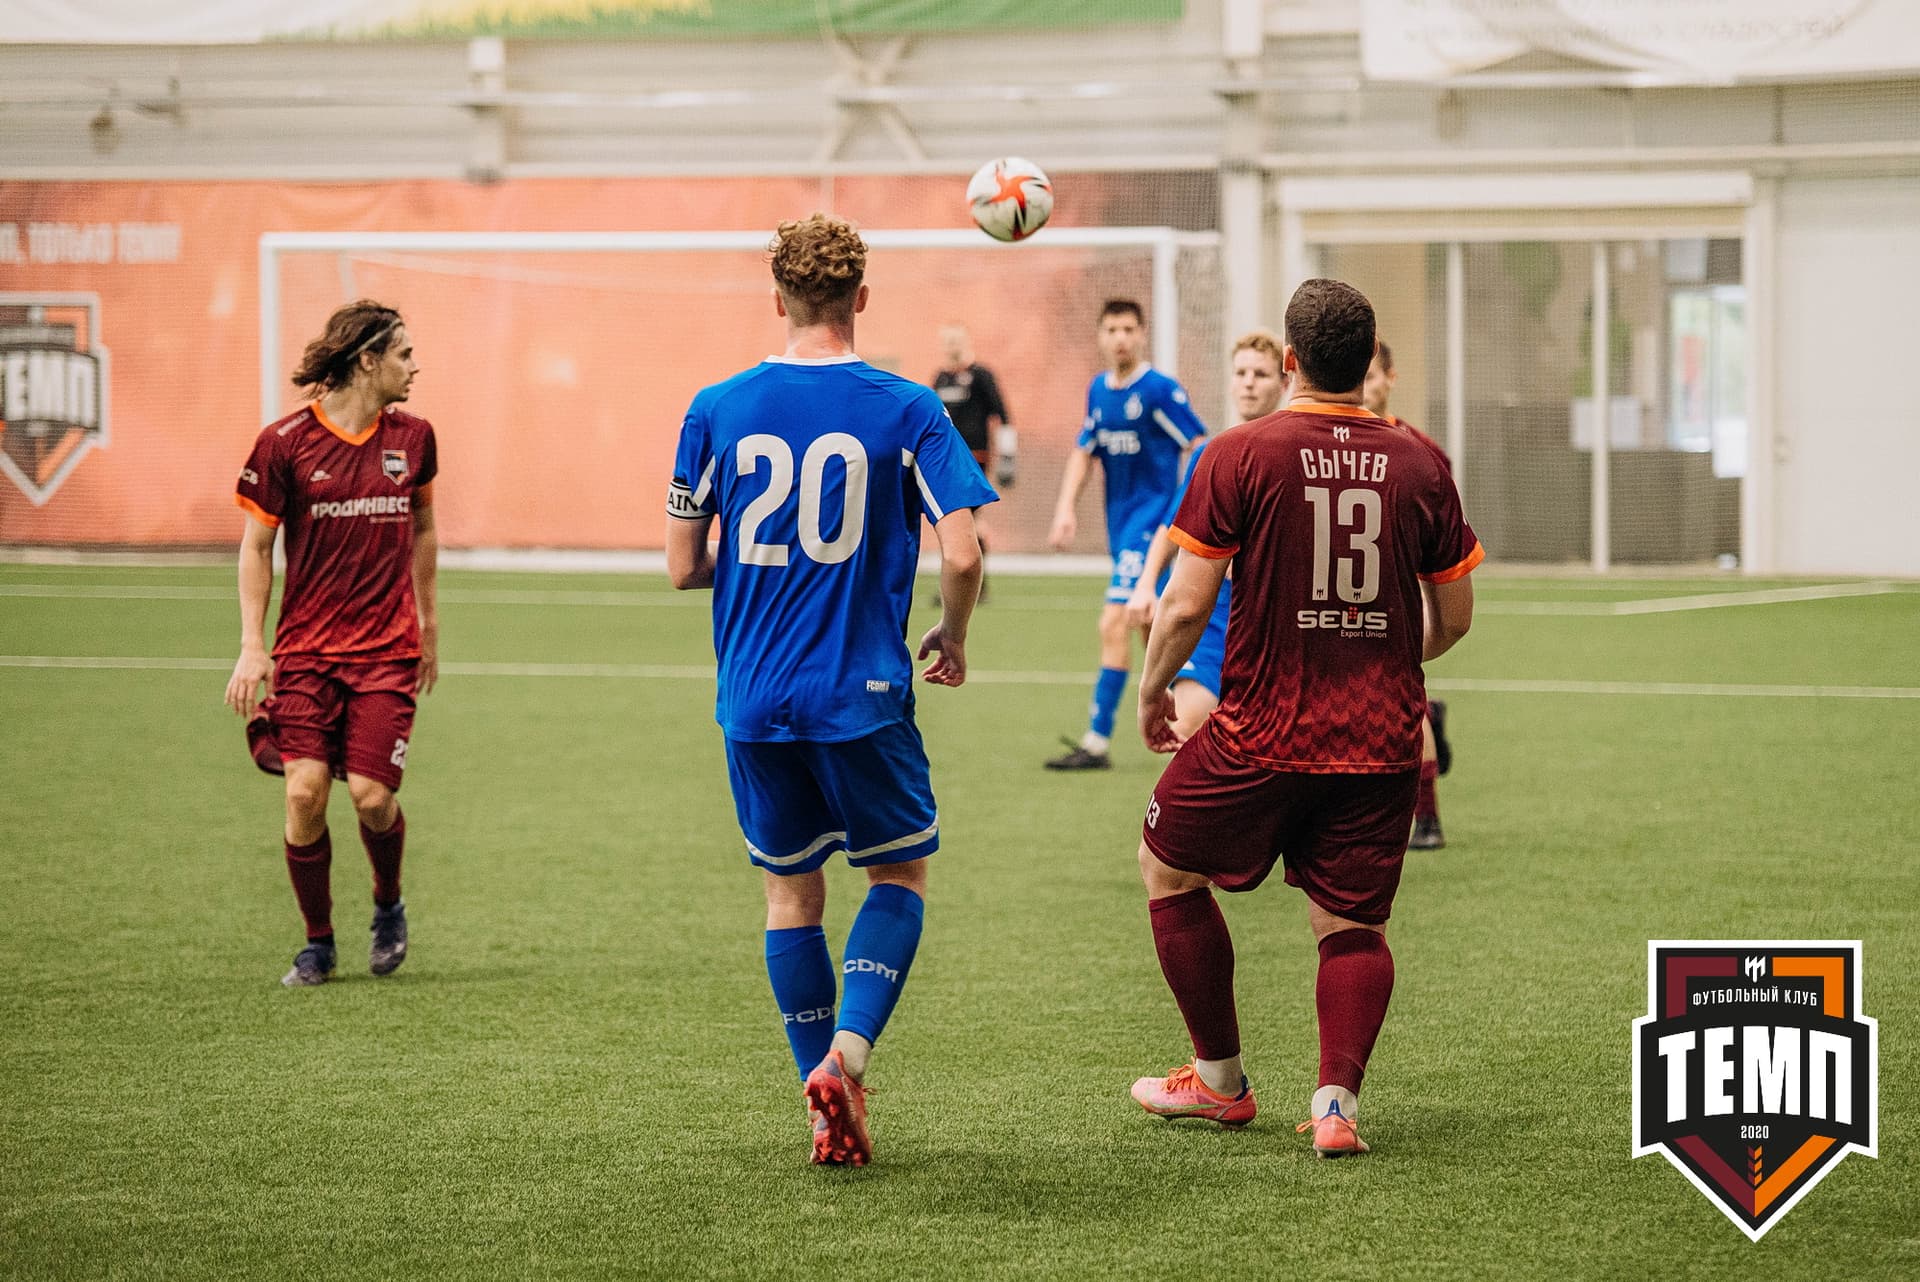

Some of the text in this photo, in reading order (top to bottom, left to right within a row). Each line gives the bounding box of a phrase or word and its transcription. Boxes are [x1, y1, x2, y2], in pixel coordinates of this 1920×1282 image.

[2, 349, 98, 430] ЕМП
[1300, 448, 1388, 482] СЫЧЕВ
[736, 432, 868, 566] 20
[1304, 486, 1382, 603] 13
[1297, 608, 1387, 630] SEUS
[1340, 629, 1364, 638] Export
